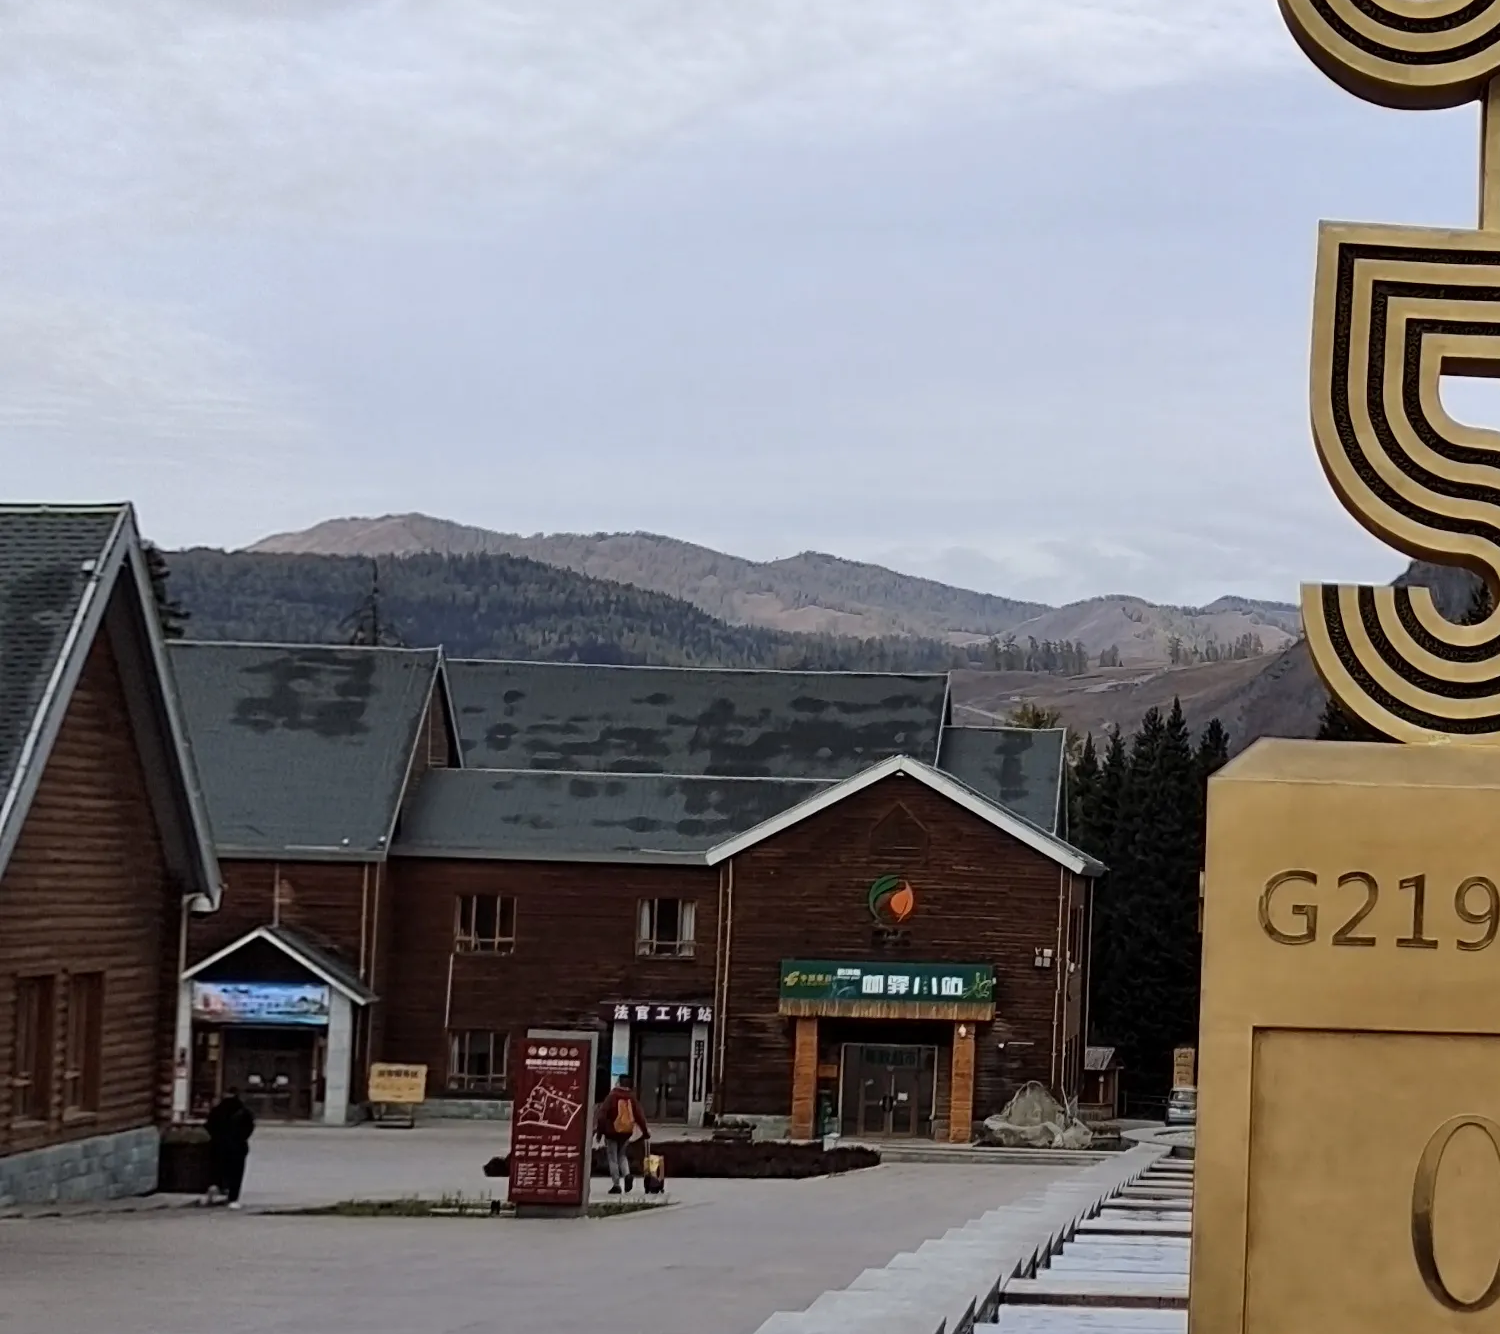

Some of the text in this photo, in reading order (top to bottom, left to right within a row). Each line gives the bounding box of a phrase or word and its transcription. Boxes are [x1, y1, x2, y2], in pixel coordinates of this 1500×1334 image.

[613, 1005, 713, 1022] 法官工作站
